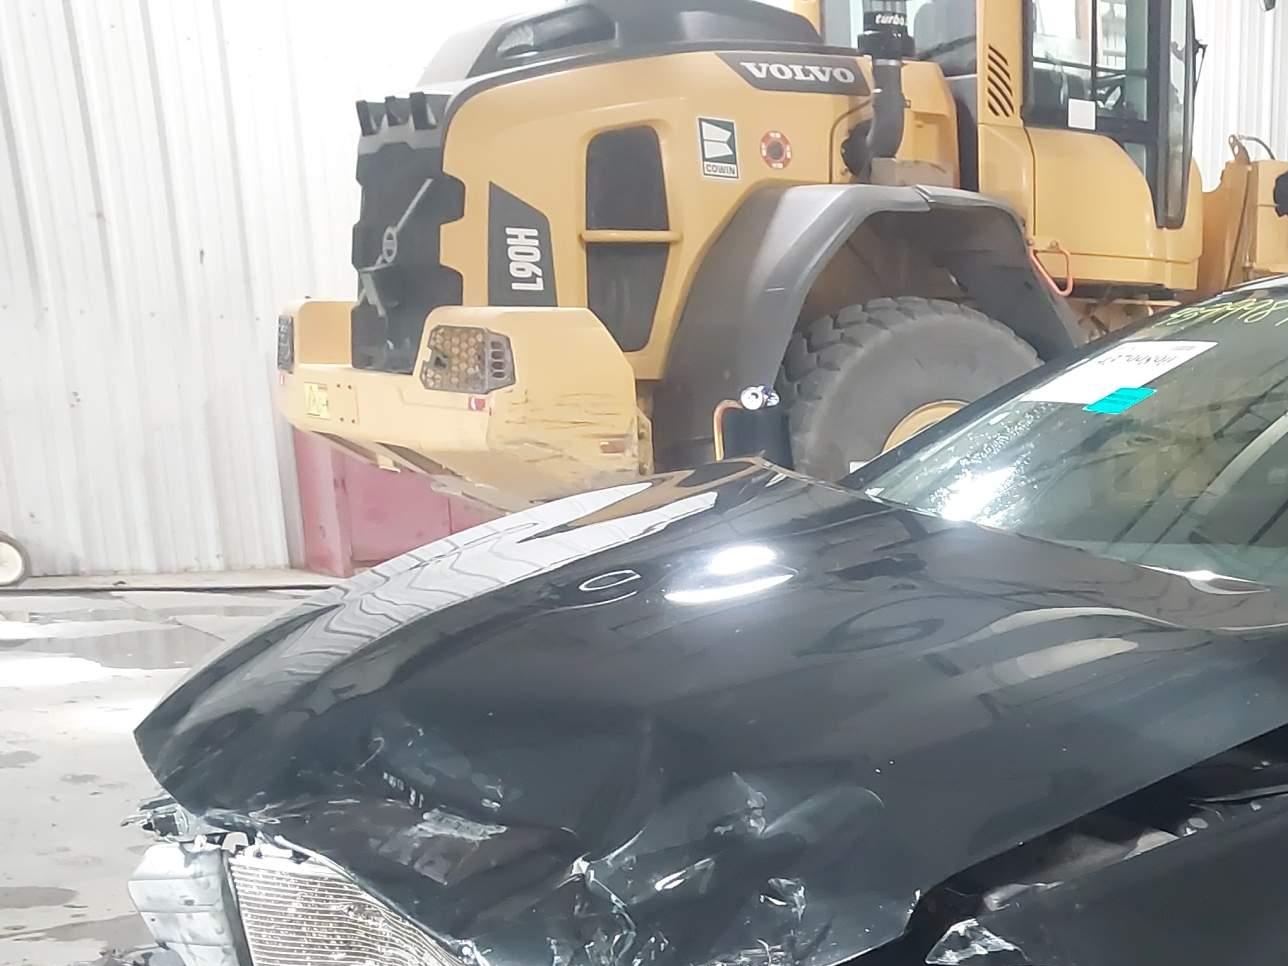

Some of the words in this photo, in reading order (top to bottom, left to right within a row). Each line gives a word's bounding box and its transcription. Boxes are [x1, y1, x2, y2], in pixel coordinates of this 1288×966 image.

[740, 62, 855, 83] VOLVO
[706, 164, 735, 175] COWIN
[505, 226, 544, 290] L90H
